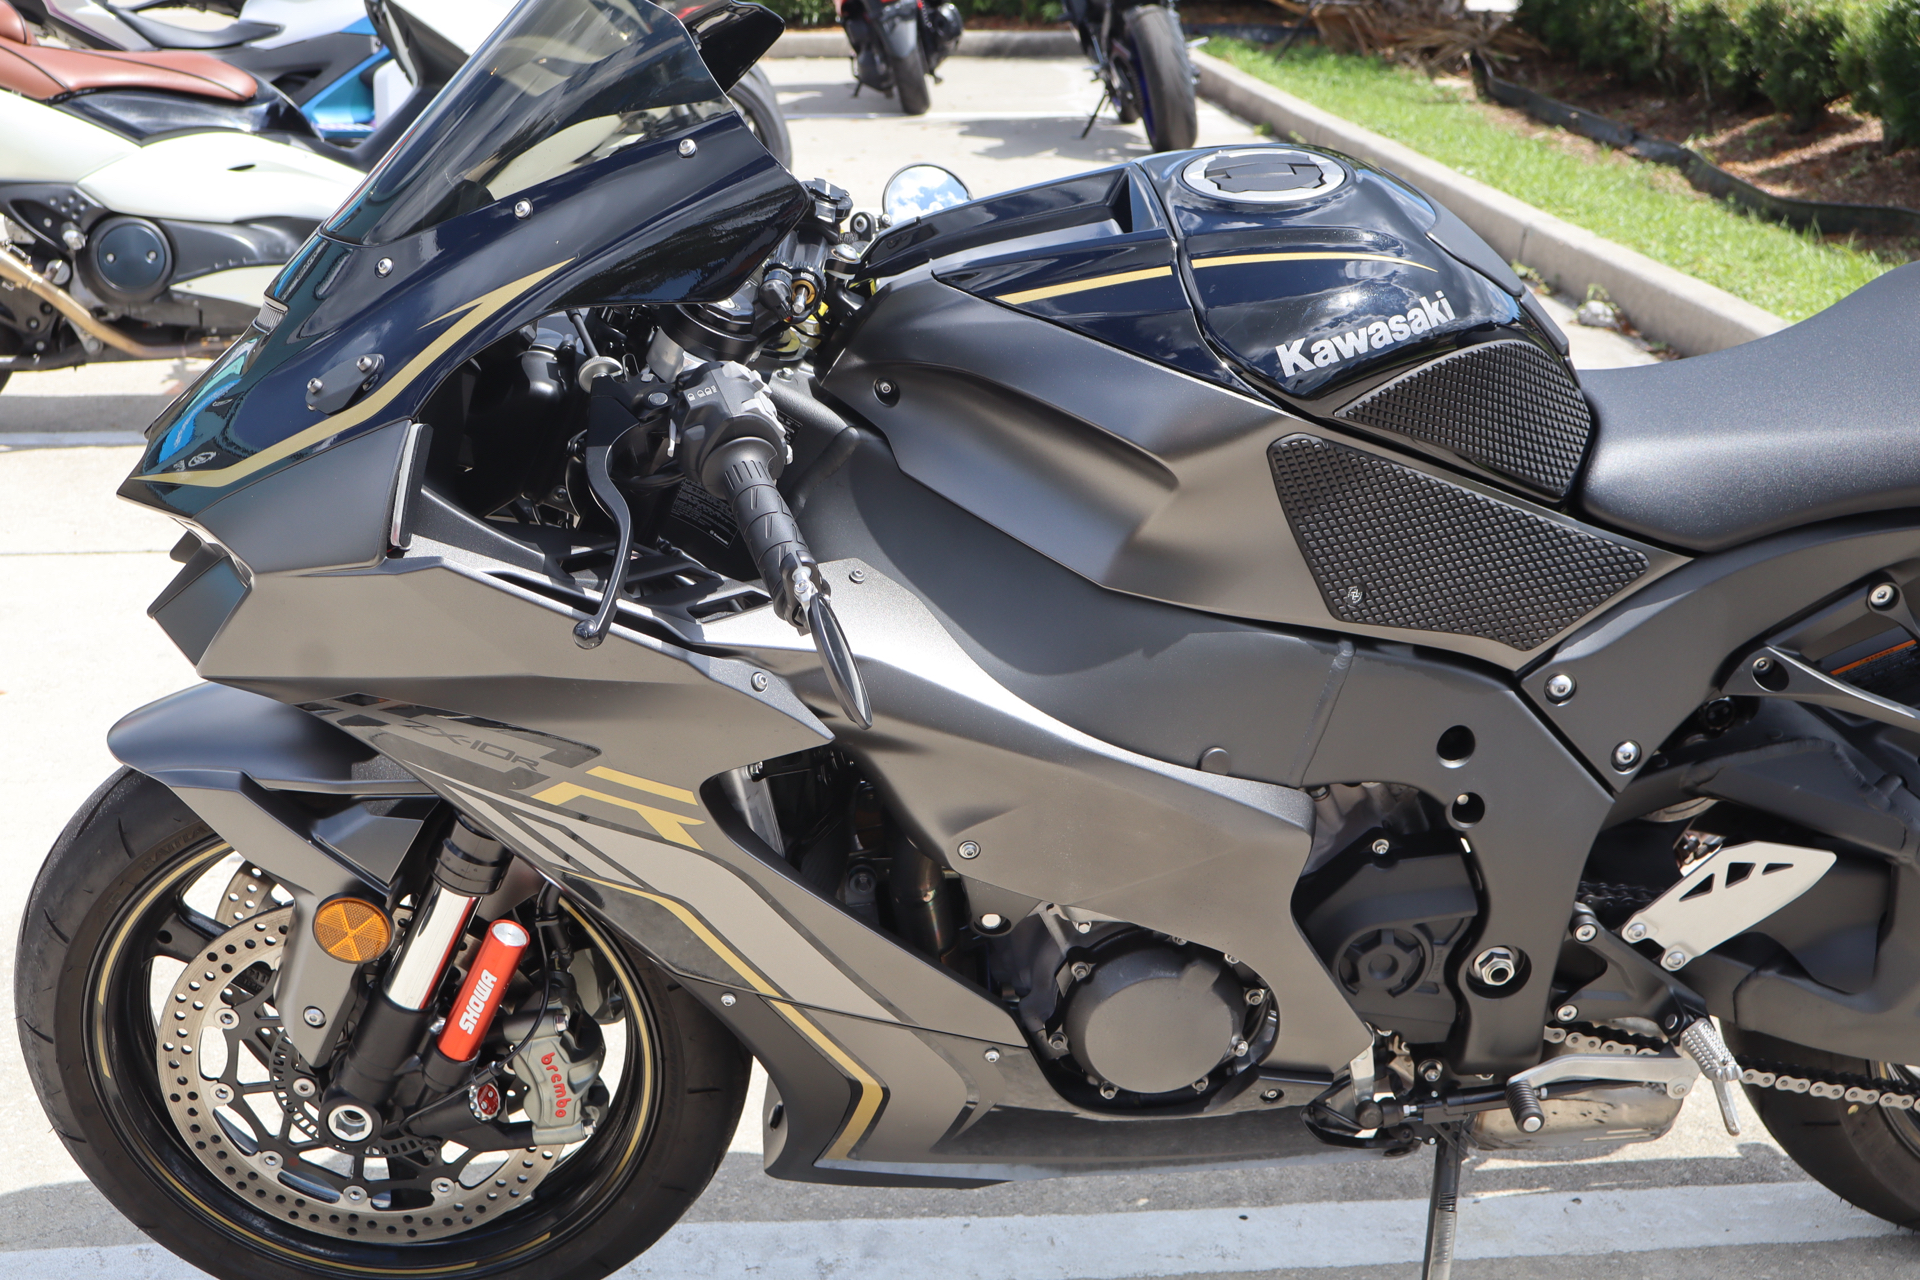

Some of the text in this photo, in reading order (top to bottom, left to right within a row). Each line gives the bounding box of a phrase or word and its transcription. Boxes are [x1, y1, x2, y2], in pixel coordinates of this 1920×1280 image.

[1275, 290, 1456, 378] Kawasaki
[403, 719, 540, 771] ZX-10R
[458, 969, 498, 1035] SHOWA
[541, 1052, 571, 1118] brembo
